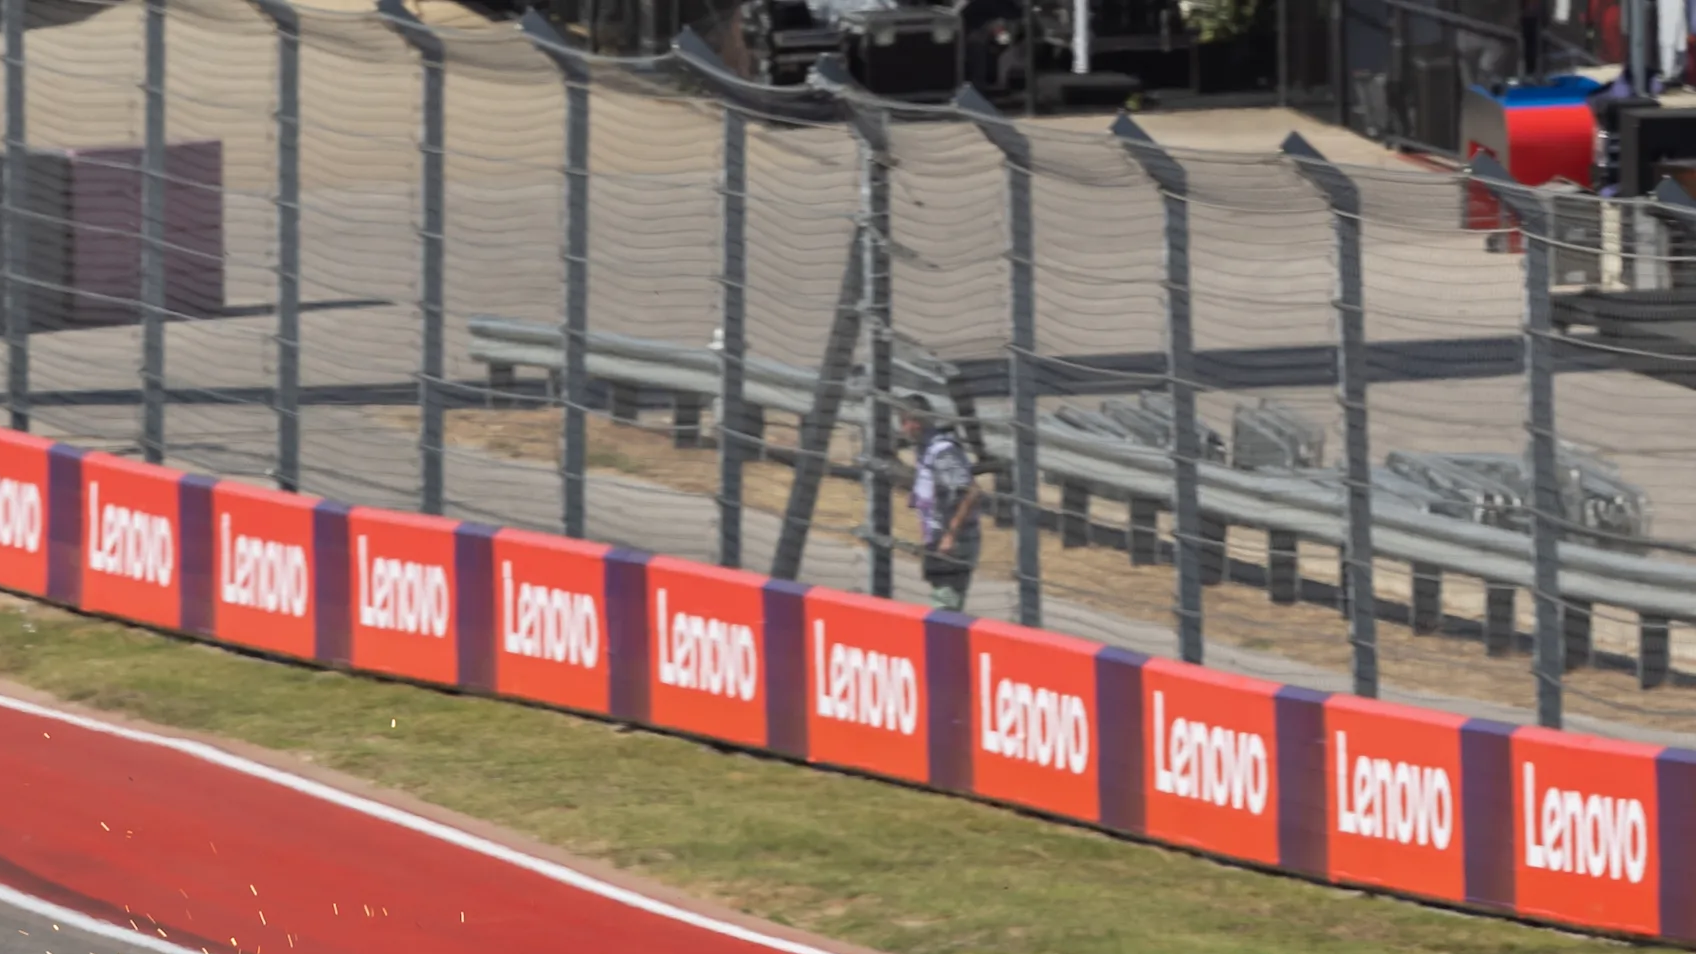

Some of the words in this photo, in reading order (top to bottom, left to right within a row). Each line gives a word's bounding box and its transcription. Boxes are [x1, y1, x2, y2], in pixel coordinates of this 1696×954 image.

[88, 481, 174, 587] Lenovo
[221, 513, 308, 617] Lenovo
[357, 535, 449, 638] Lenovo
[502, 561, 599, 668] Lenovo
[657, 588, 757, 701] Lenovo
[814, 619, 918, 735] Lenovo
[980, 652, 1089, 774] Lenovo
[1153, 690, 1268, 815] Lenovo
[1335, 730, 1453, 850] Lenovo
[1523, 761, 1647, 884] Lenovo
